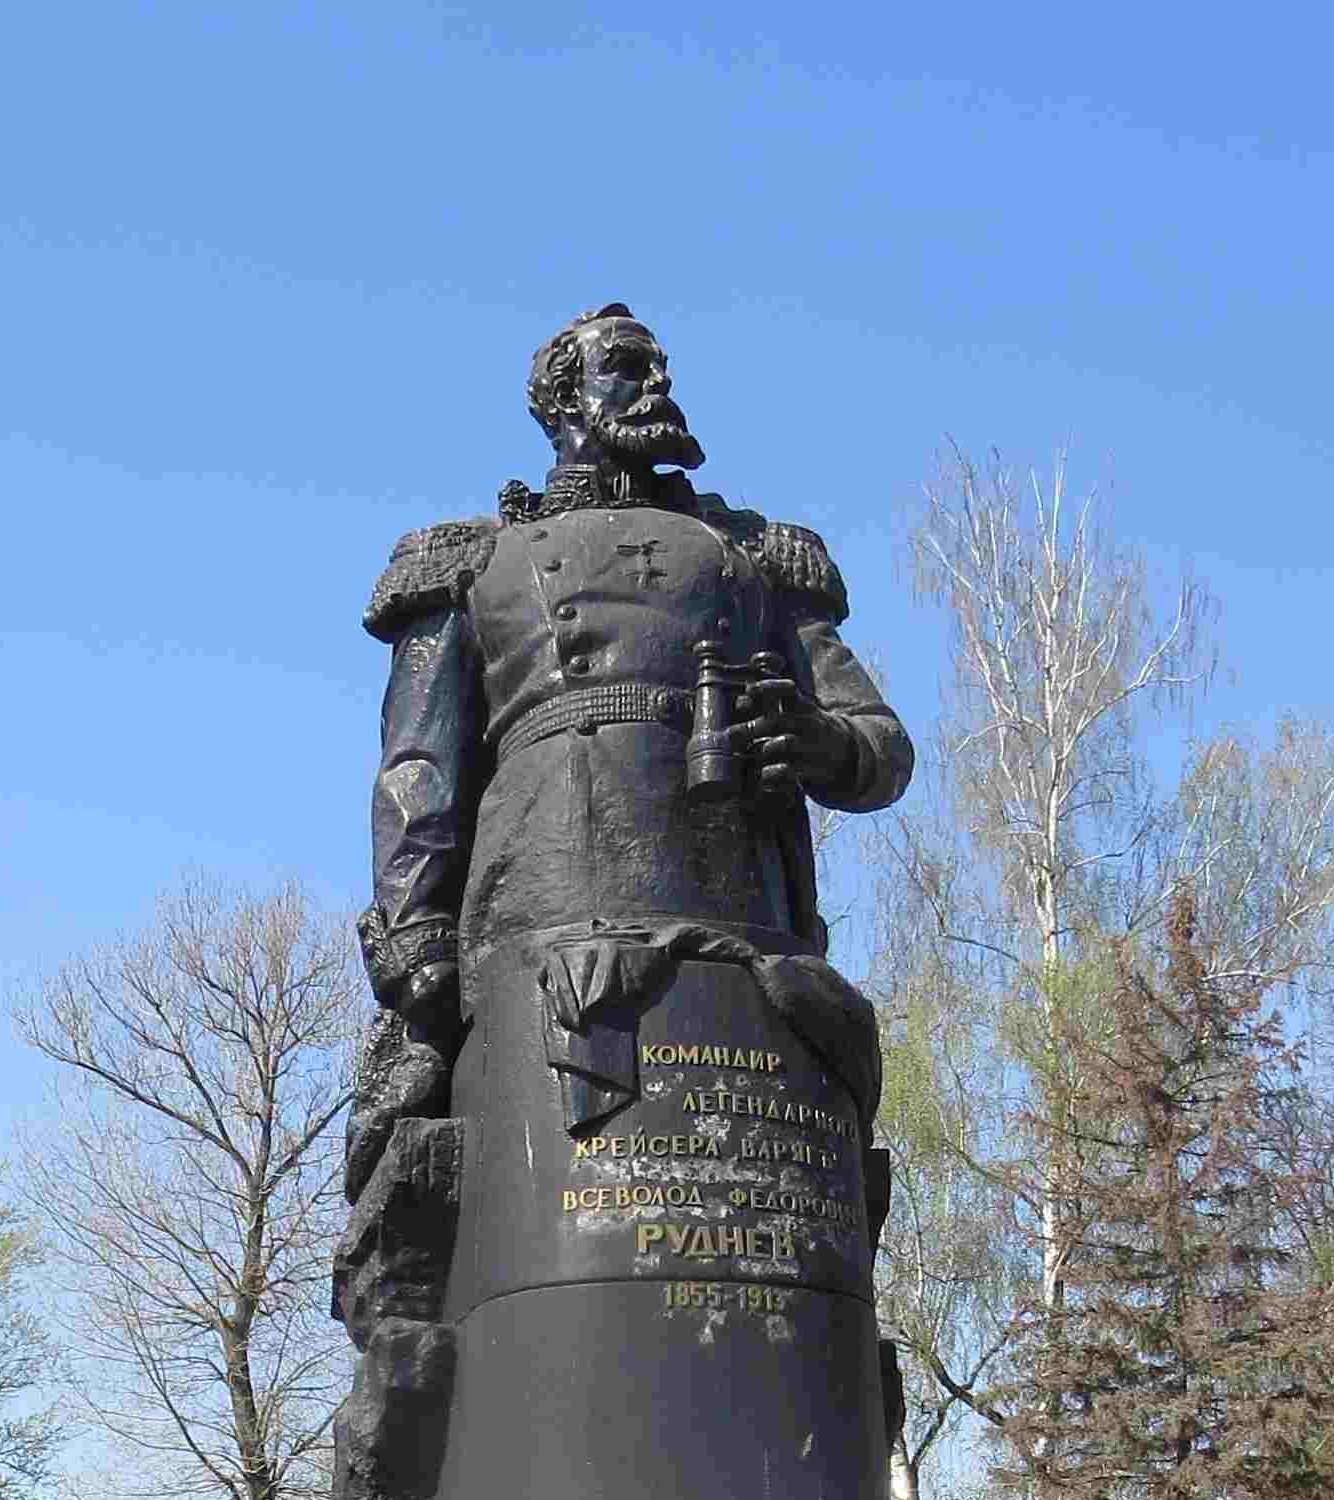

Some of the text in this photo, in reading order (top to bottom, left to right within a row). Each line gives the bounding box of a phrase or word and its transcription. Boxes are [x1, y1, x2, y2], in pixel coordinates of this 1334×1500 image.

[641, 1044, 782, 1073] КОМАНДИР
[575, 1126, 721, 1159] КРЕЙСЕРА
[562, 1185, 864, 1225] ВСЕВОЛОД ФЕДОРОВИ
[634, 1223, 796, 1259] РУДНЕВ
